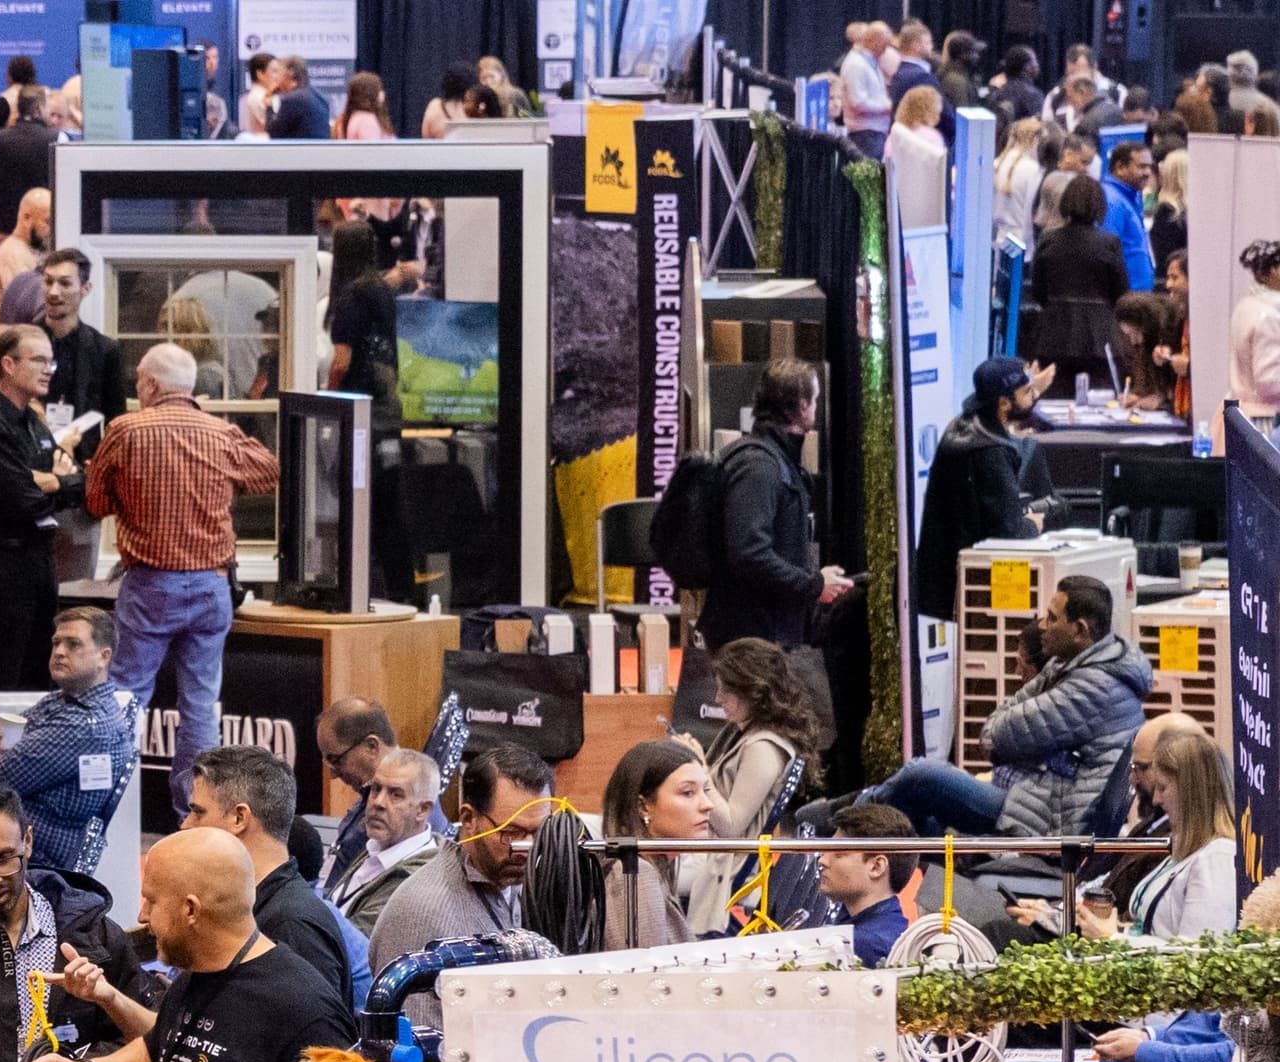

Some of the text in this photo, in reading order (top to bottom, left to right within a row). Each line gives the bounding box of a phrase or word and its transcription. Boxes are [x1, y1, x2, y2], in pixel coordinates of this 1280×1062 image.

[162, 3, 213, 13] ELEVATE
[592, 174, 617, 186] FODS
[653, 193, 682, 490] REUSABLE CONSTRUCTION
